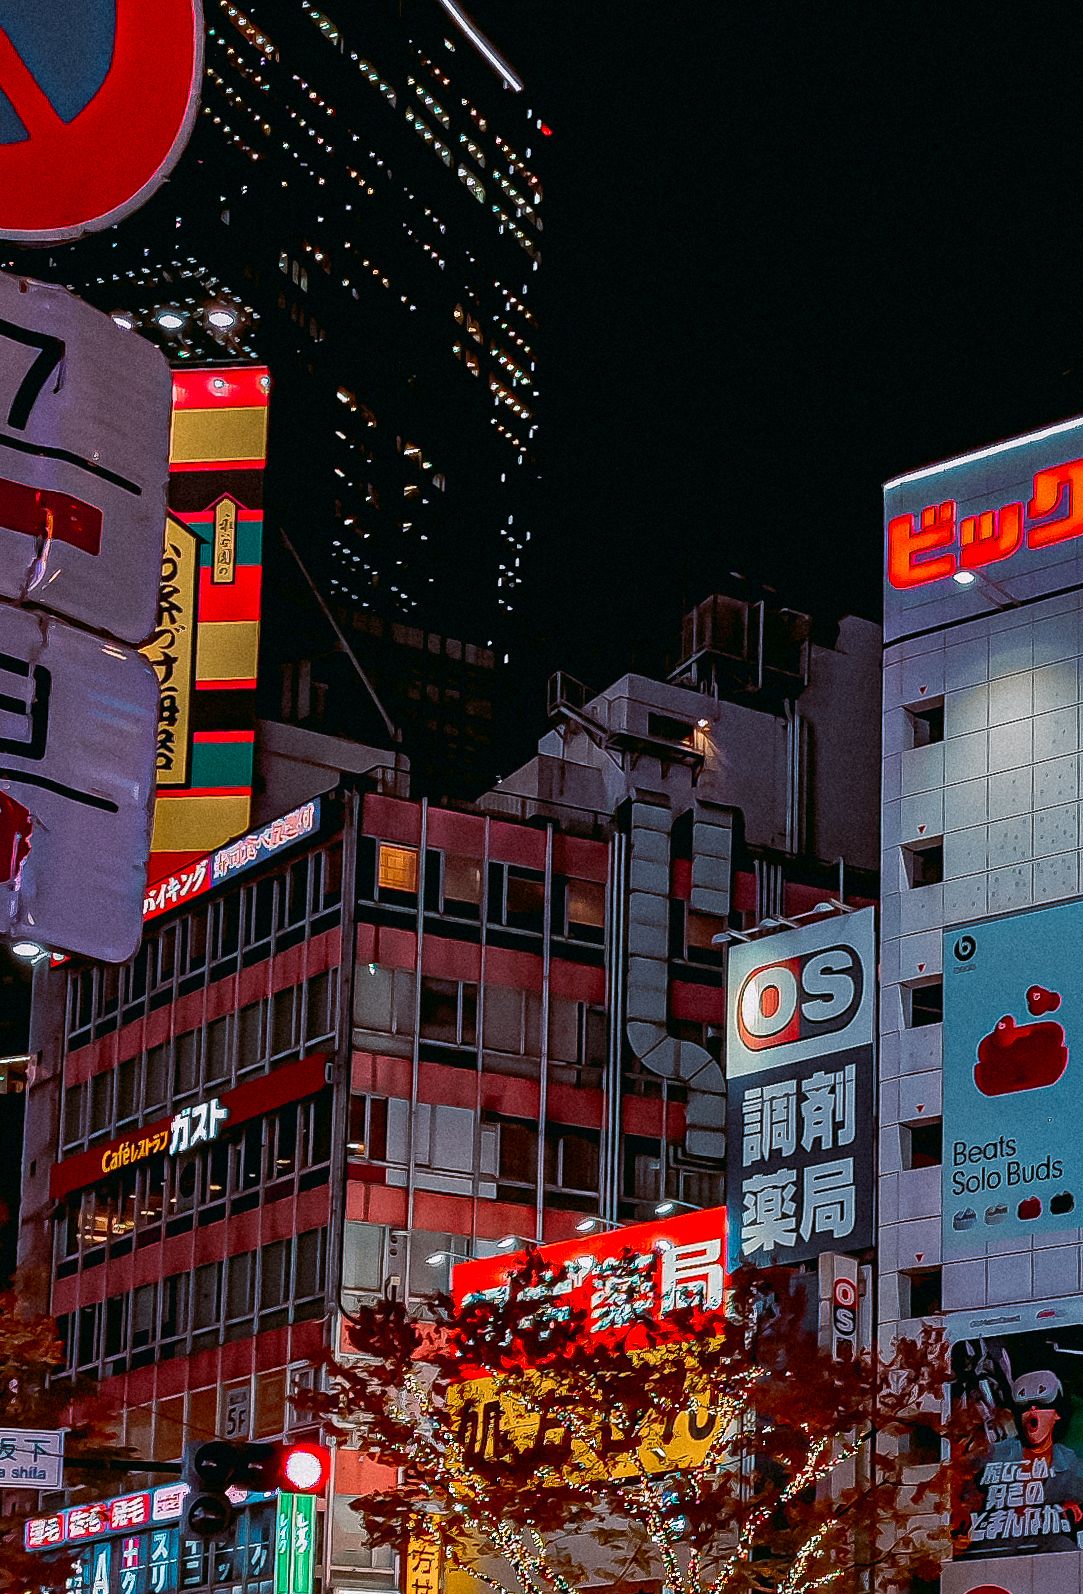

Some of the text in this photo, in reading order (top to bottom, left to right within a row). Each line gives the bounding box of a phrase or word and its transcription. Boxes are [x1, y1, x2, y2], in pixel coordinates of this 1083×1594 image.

[741, 949, 855, 1037] OS
[742, 1064, 857, 1168] 調剤
[951, 1156, 1064, 1197] Solo Buds
[952, 1136, 1018, 1166] Beats
[741, 1157, 856, 1252] 薬局
[226, 1406, 246, 1437] 5F
